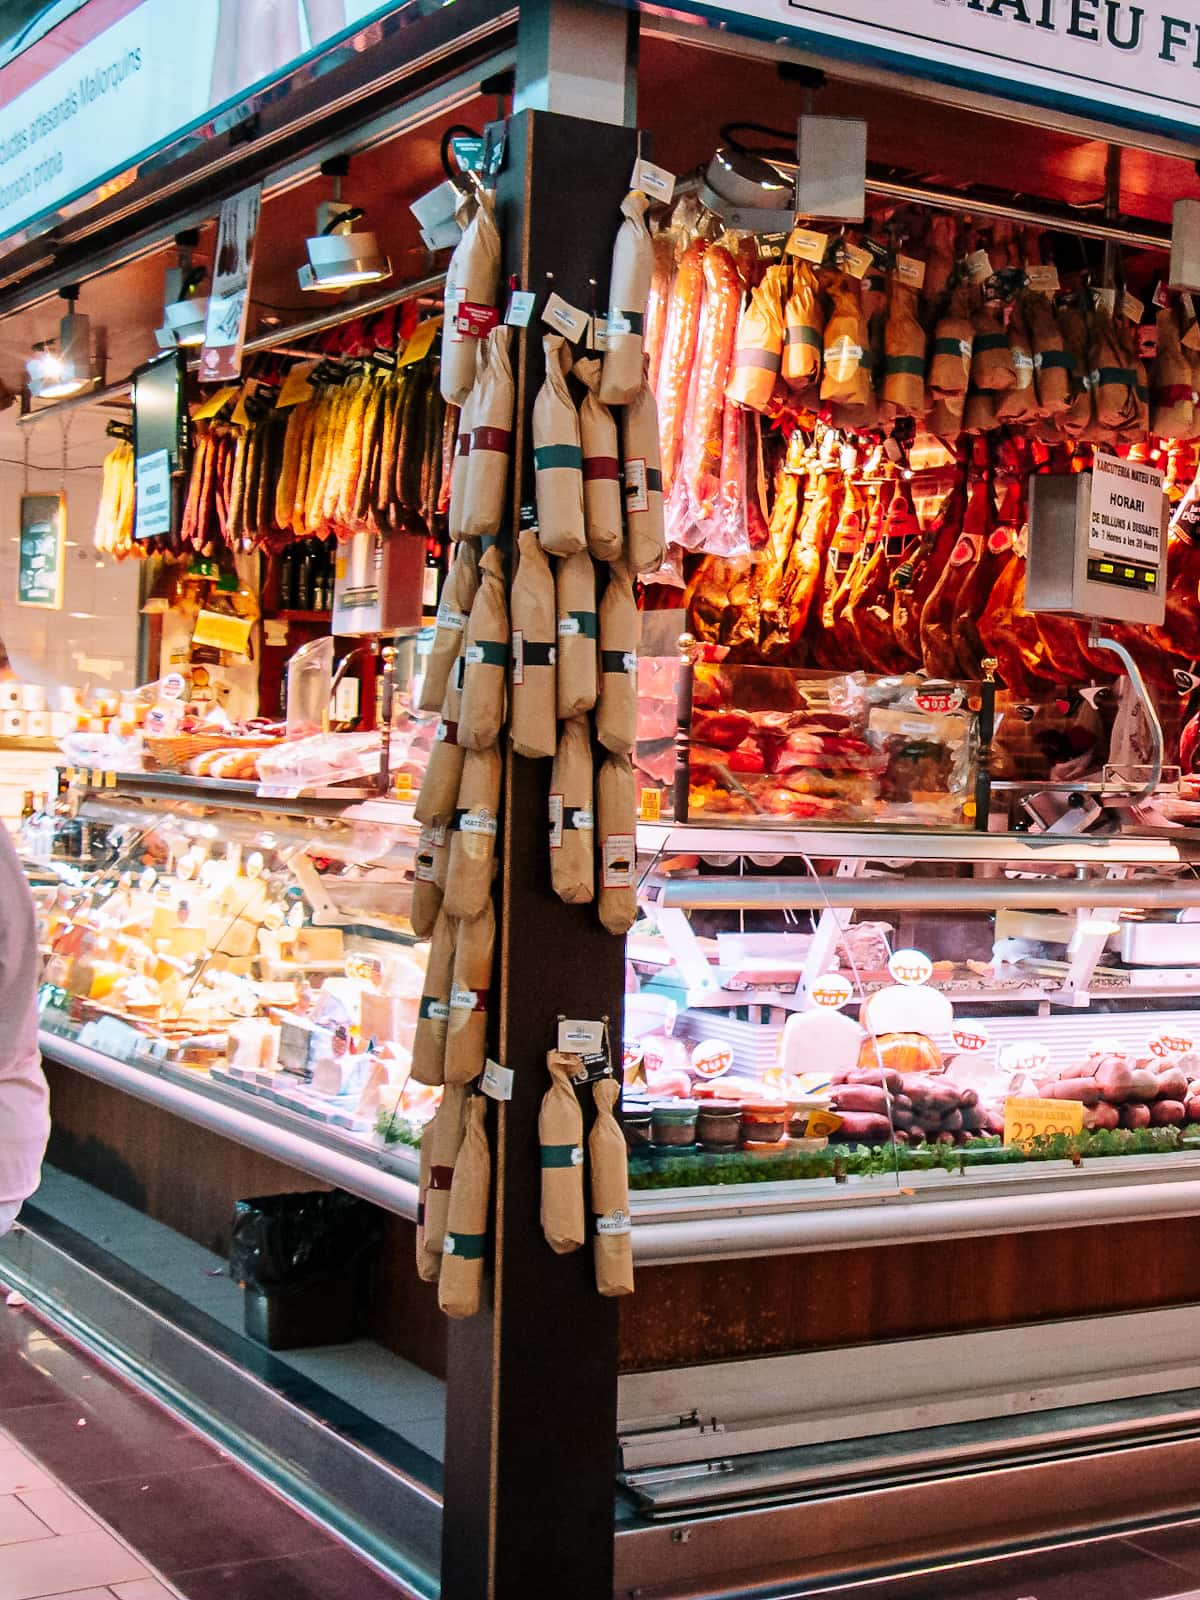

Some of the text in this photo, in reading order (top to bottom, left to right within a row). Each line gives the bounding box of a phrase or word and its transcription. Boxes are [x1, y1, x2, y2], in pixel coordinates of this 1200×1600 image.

[940, 0, 1145, 50] ATEU
[80, 47, 142, 107] Mallorquins
[1092, 512, 1100, 523] DE
[1110, 493, 1145, 513] HORARI
